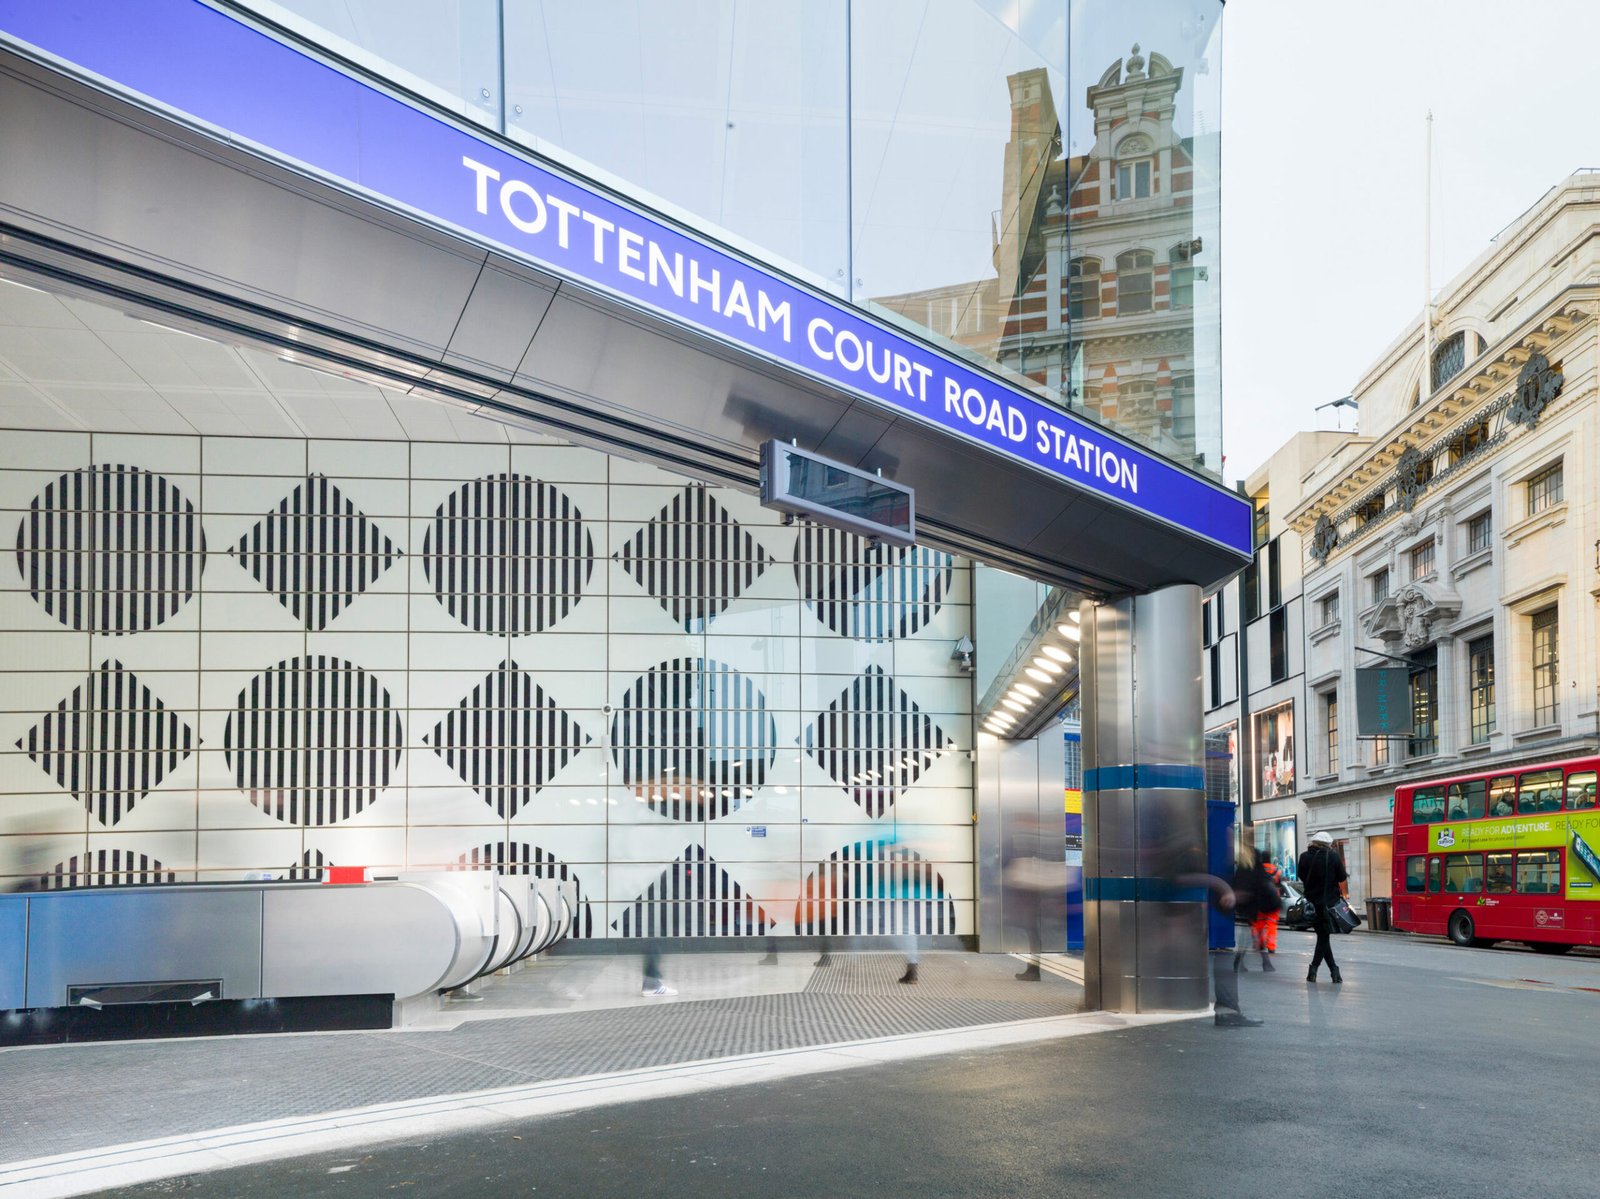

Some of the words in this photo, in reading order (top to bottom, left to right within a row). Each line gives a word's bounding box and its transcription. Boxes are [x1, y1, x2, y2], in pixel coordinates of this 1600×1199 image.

[462, 155, 791, 343] TOTTENHAM
[807, 317, 932, 402] COURT
[944, 377, 1028, 442] ROAD
[1036, 419, 1138, 493] STATION
[1585, 817, 1600, 828] FO
[1485, 825, 1500, 835] FOR
